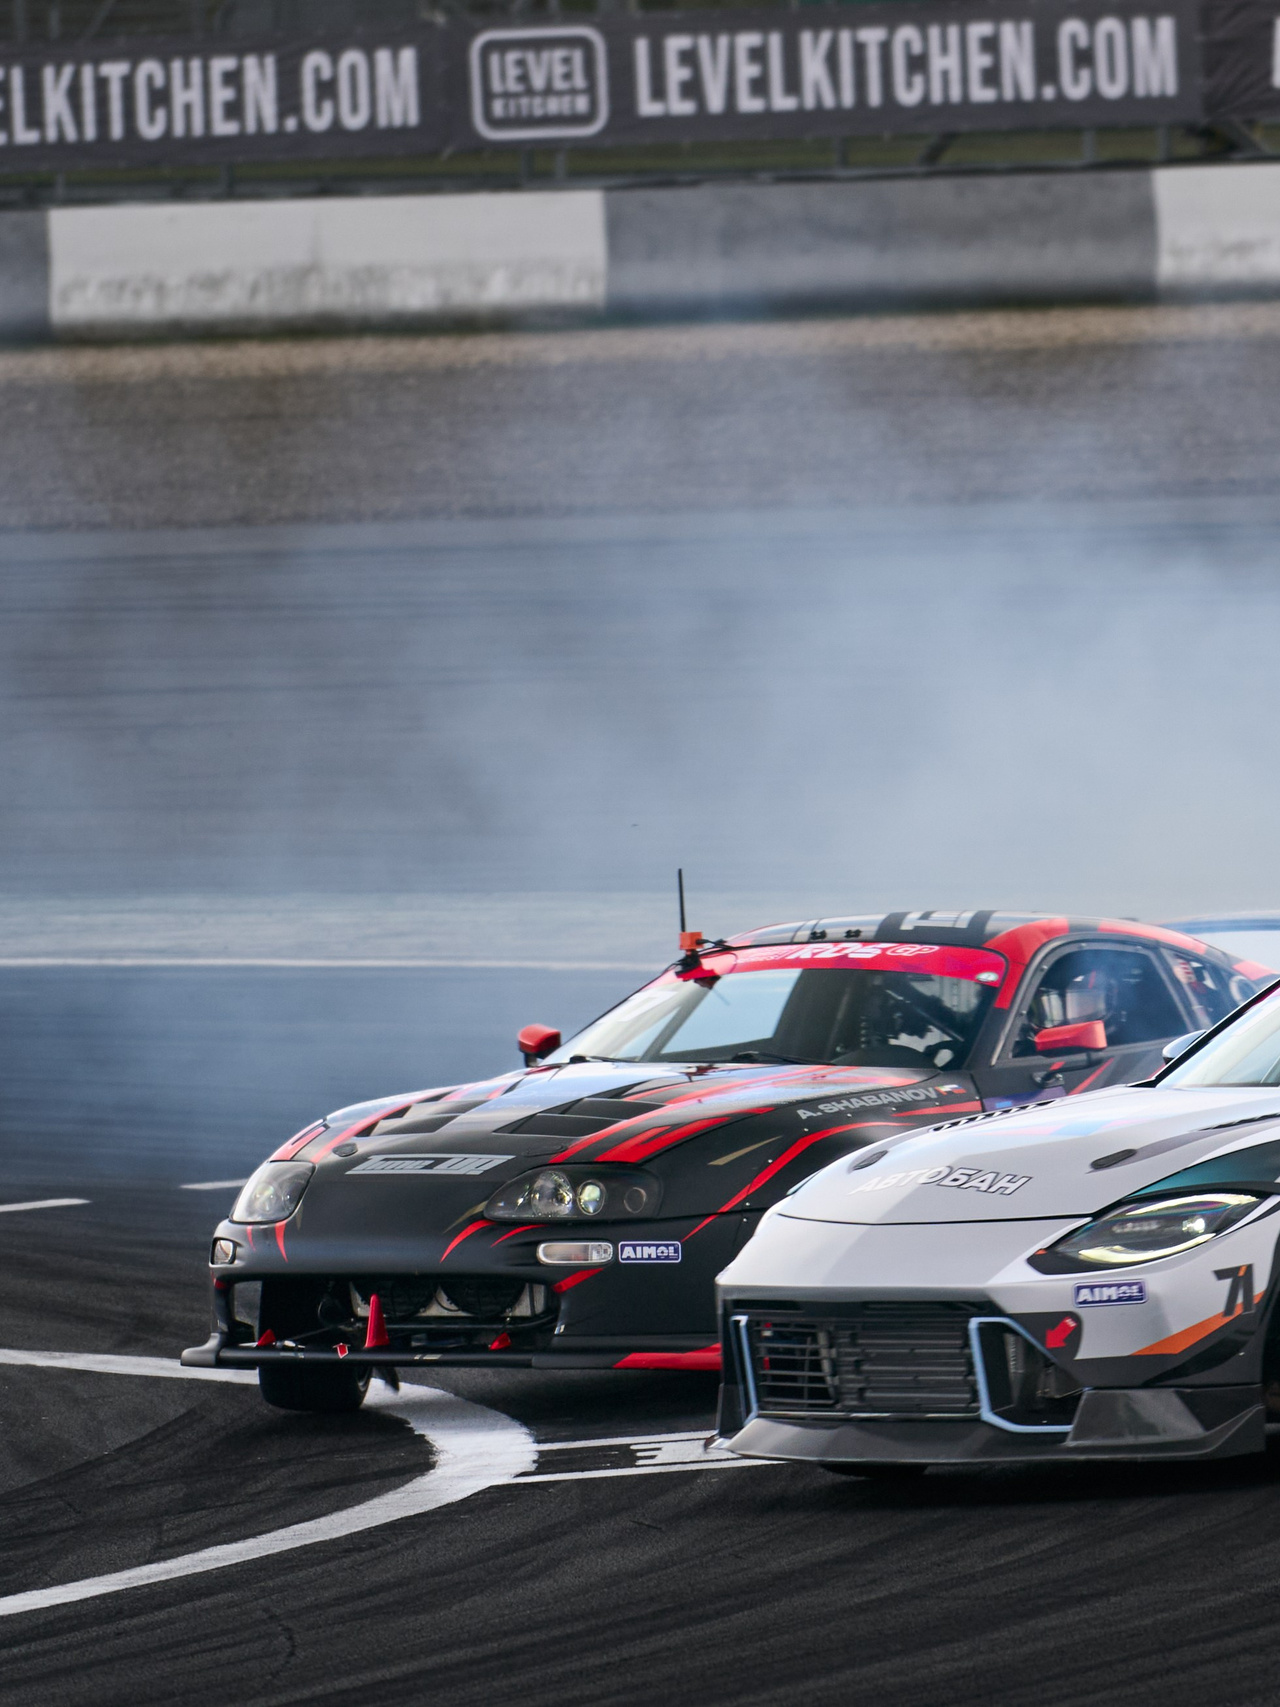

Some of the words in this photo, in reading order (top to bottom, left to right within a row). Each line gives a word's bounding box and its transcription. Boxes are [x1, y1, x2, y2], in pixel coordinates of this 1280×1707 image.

[489, 48, 588, 93] LEVEL
[634, 15, 1179, 117] LEVELKITCHEN.COM
[491, 94, 590, 118] KITCHEN
[796, 1108, 823, 1120] A.
[818, 1086, 938, 1113] SHABANOV
[850, 1166, 1034, 1196] АВТОБАН
[621, 1246, 679, 1259] AIMOL
